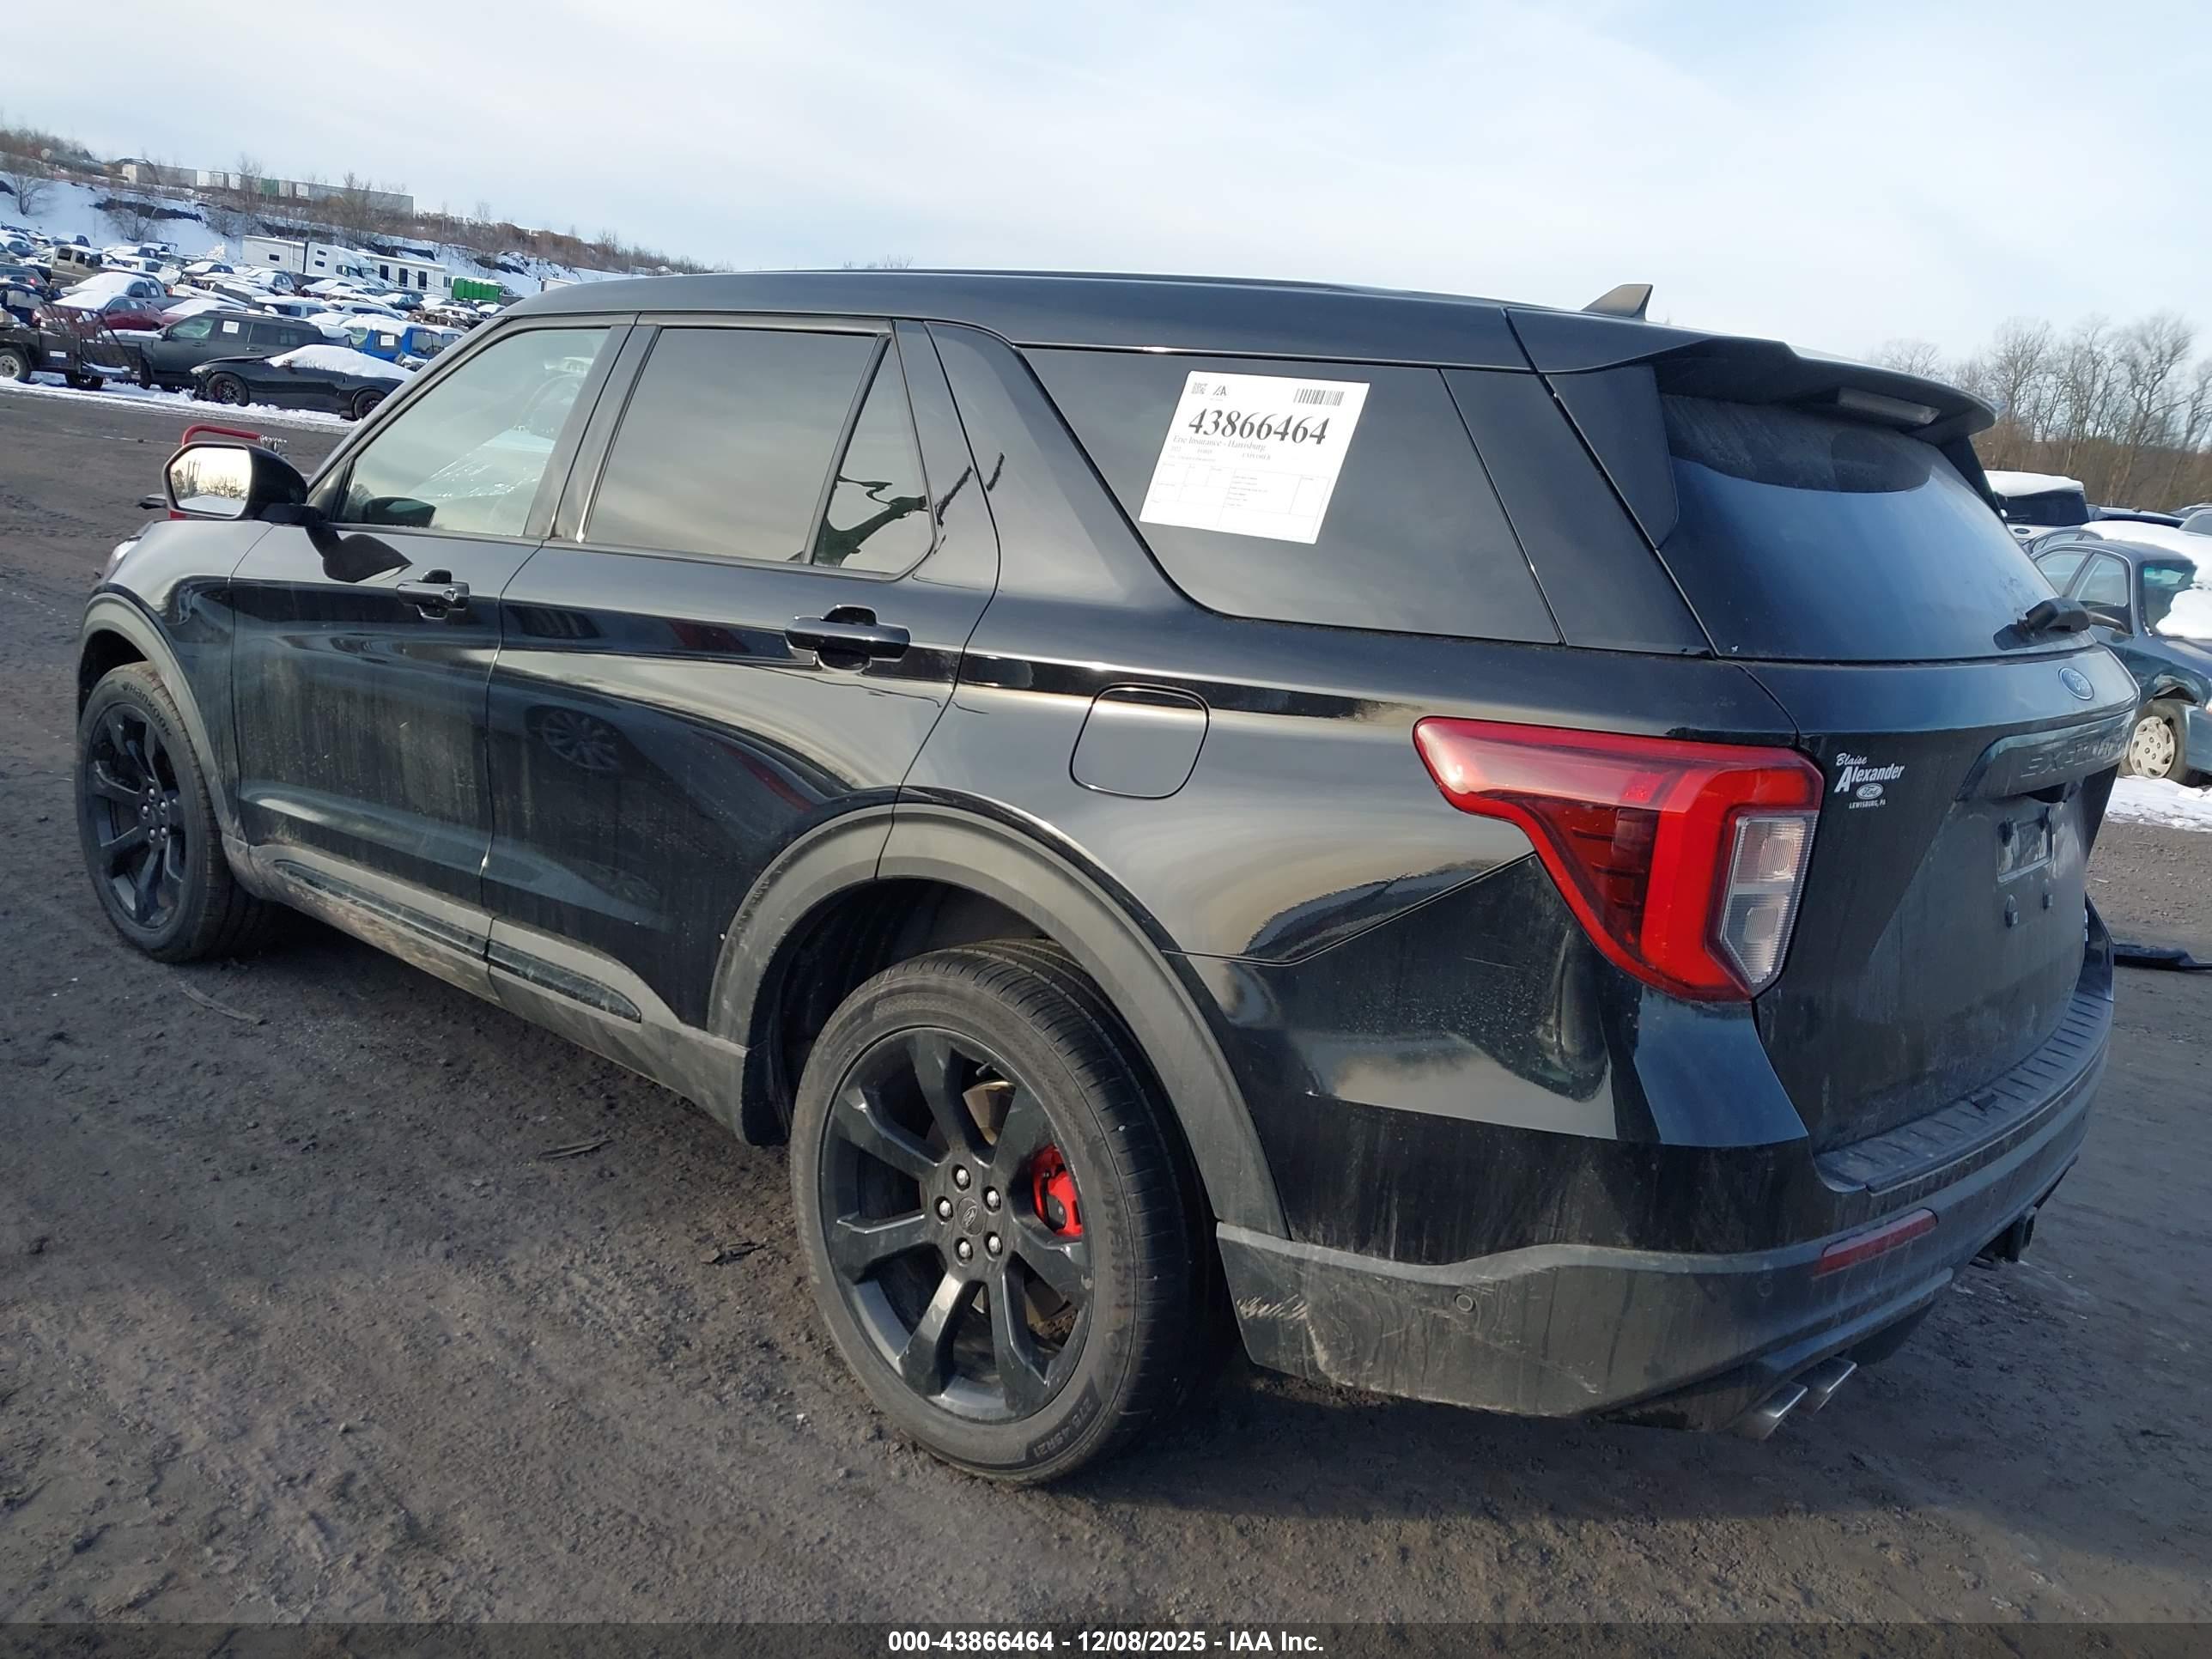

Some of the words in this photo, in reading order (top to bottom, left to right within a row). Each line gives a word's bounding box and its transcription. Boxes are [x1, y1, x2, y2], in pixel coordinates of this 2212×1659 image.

[1188, 408, 1330, 445] 43866464
[1188, 436, 1222, 447] Insurance
[1228, 439, 1266, 452] Harrisburg
[1836, 752, 1868, 766] Blaise
[1834, 763, 1905, 793] Alexander
